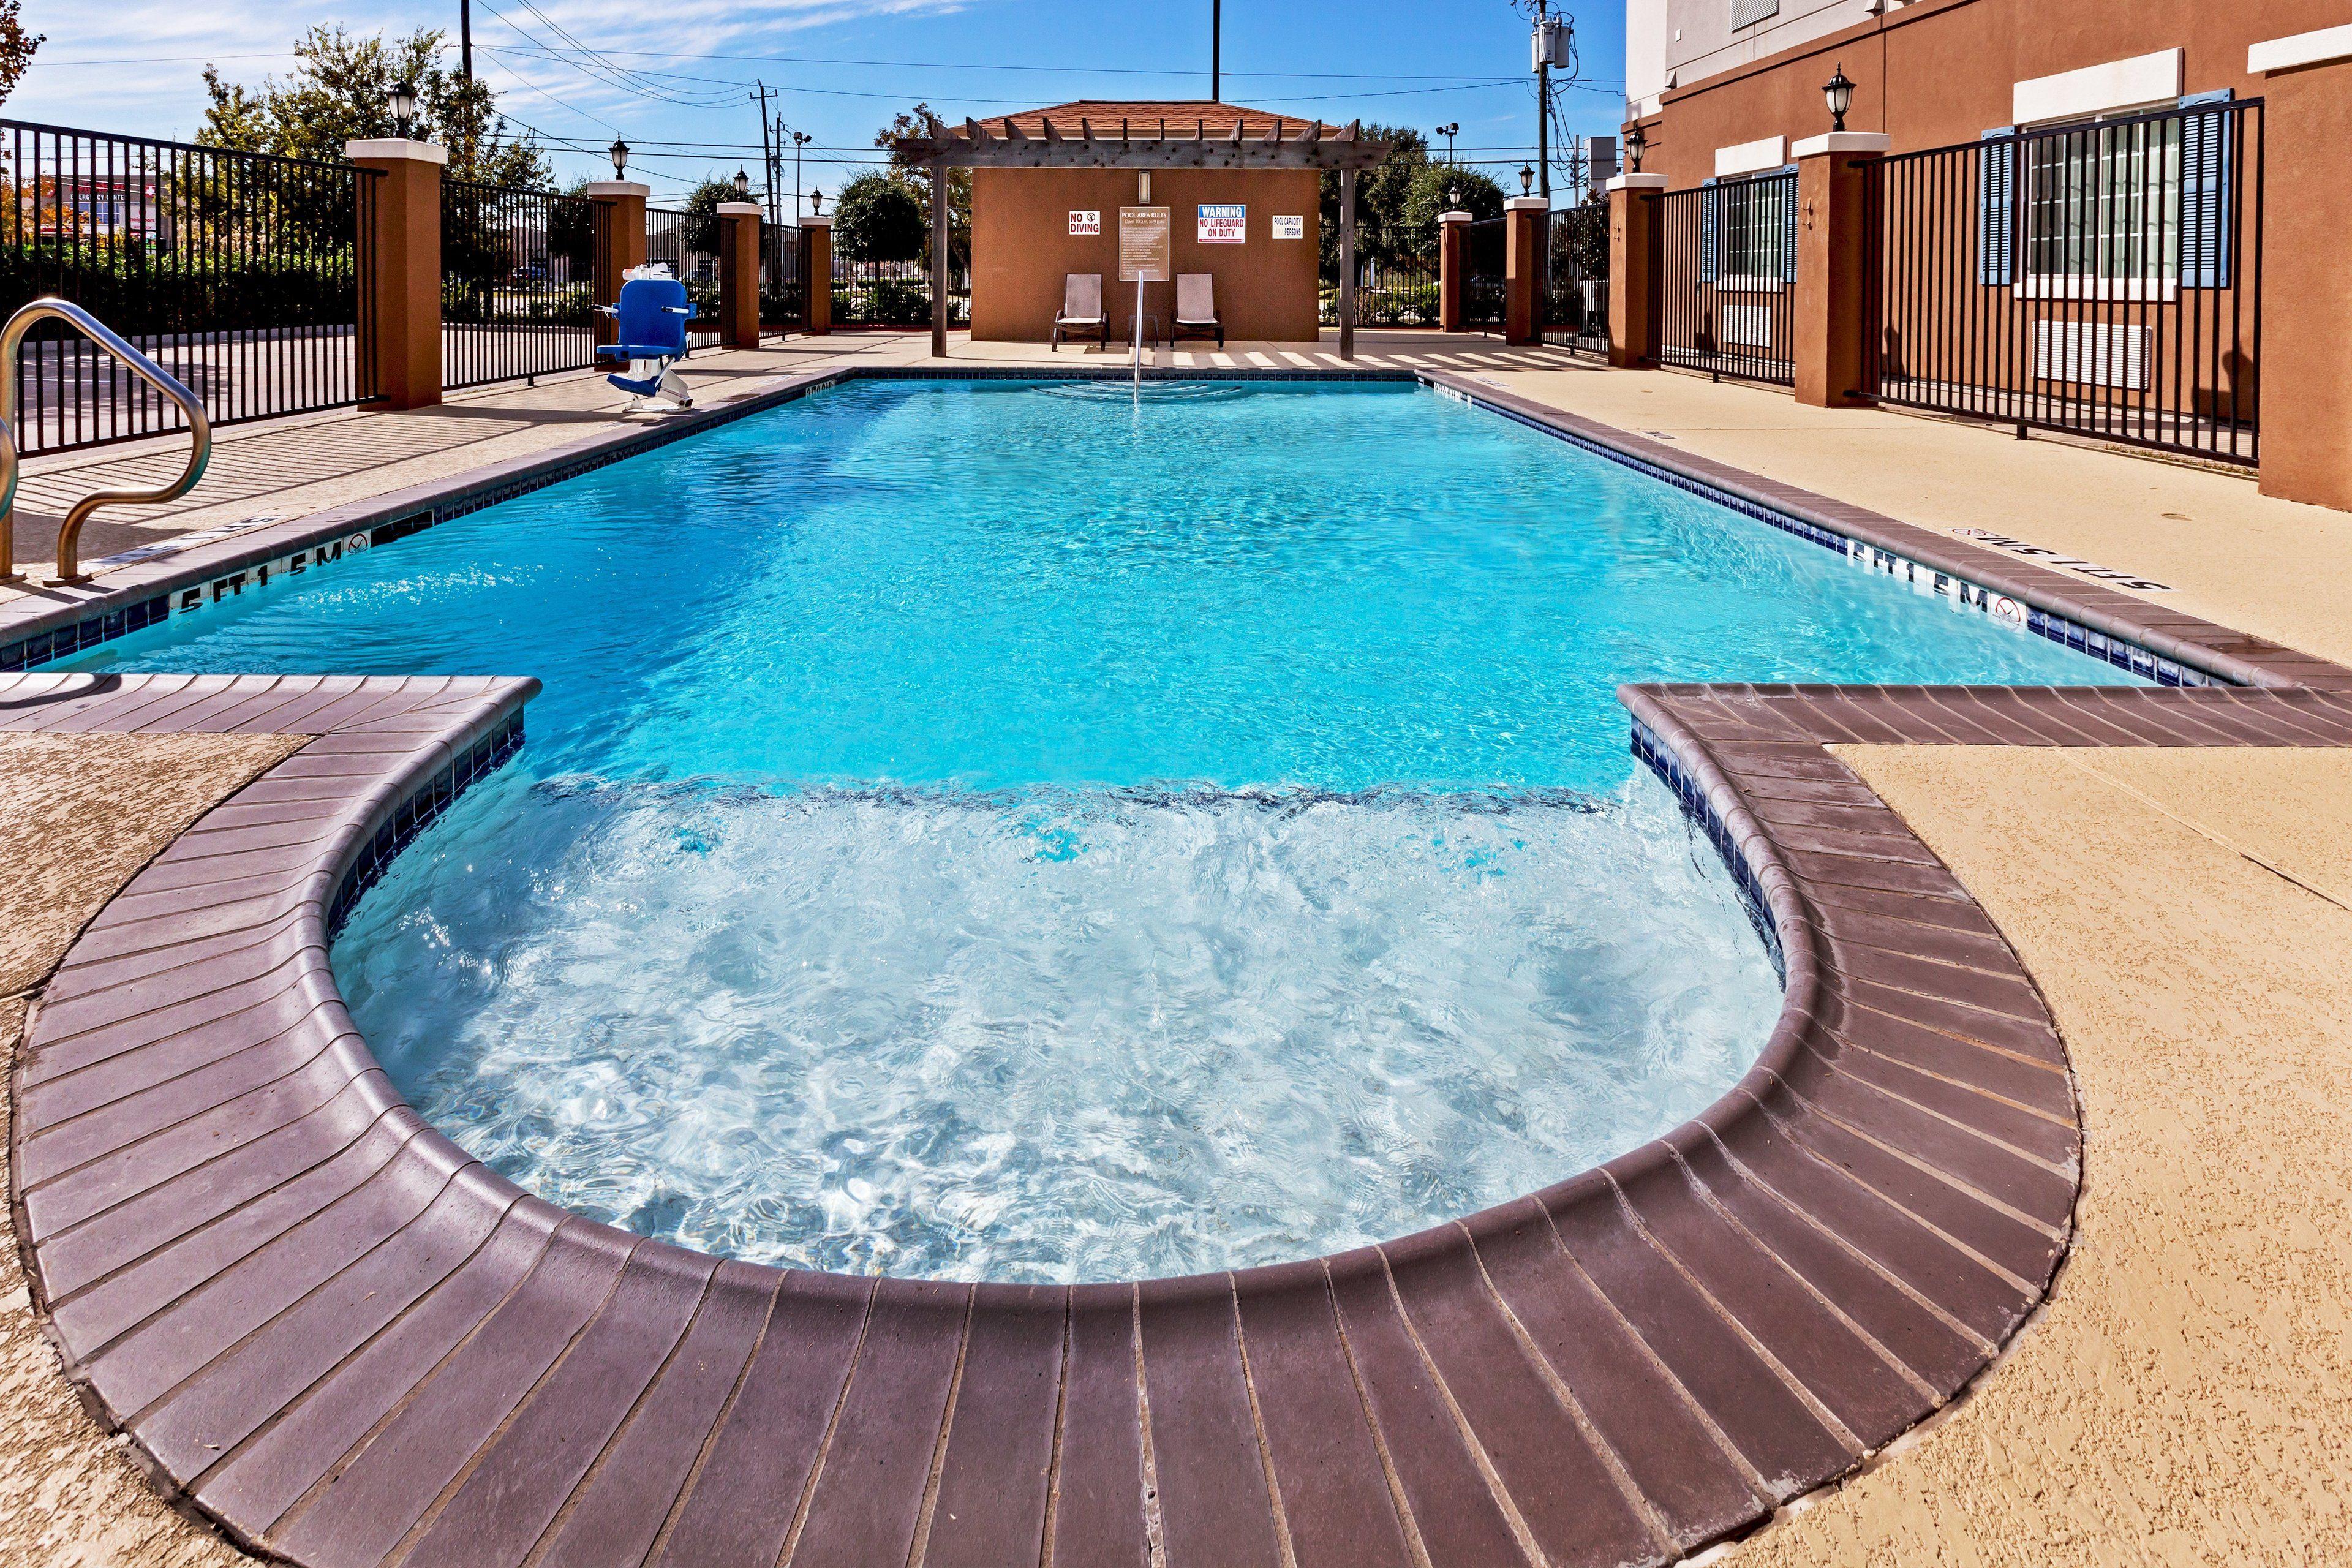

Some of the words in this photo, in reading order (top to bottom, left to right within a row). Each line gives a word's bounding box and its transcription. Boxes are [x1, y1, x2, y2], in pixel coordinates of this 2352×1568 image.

[1202, 206, 1242, 217] WARNING
[1071, 213, 1082, 222] NO
[1199, 219, 1208, 227] NO
[1210, 219, 1244, 227] LIFEGUARD
[1071, 224, 1099, 232] DIVING
[1208, 228, 1216, 237] ON
[1219, 228, 1235, 237] DUTY
[178, 587, 203, 614] 5
[1960, 581, 1988, 613] M
